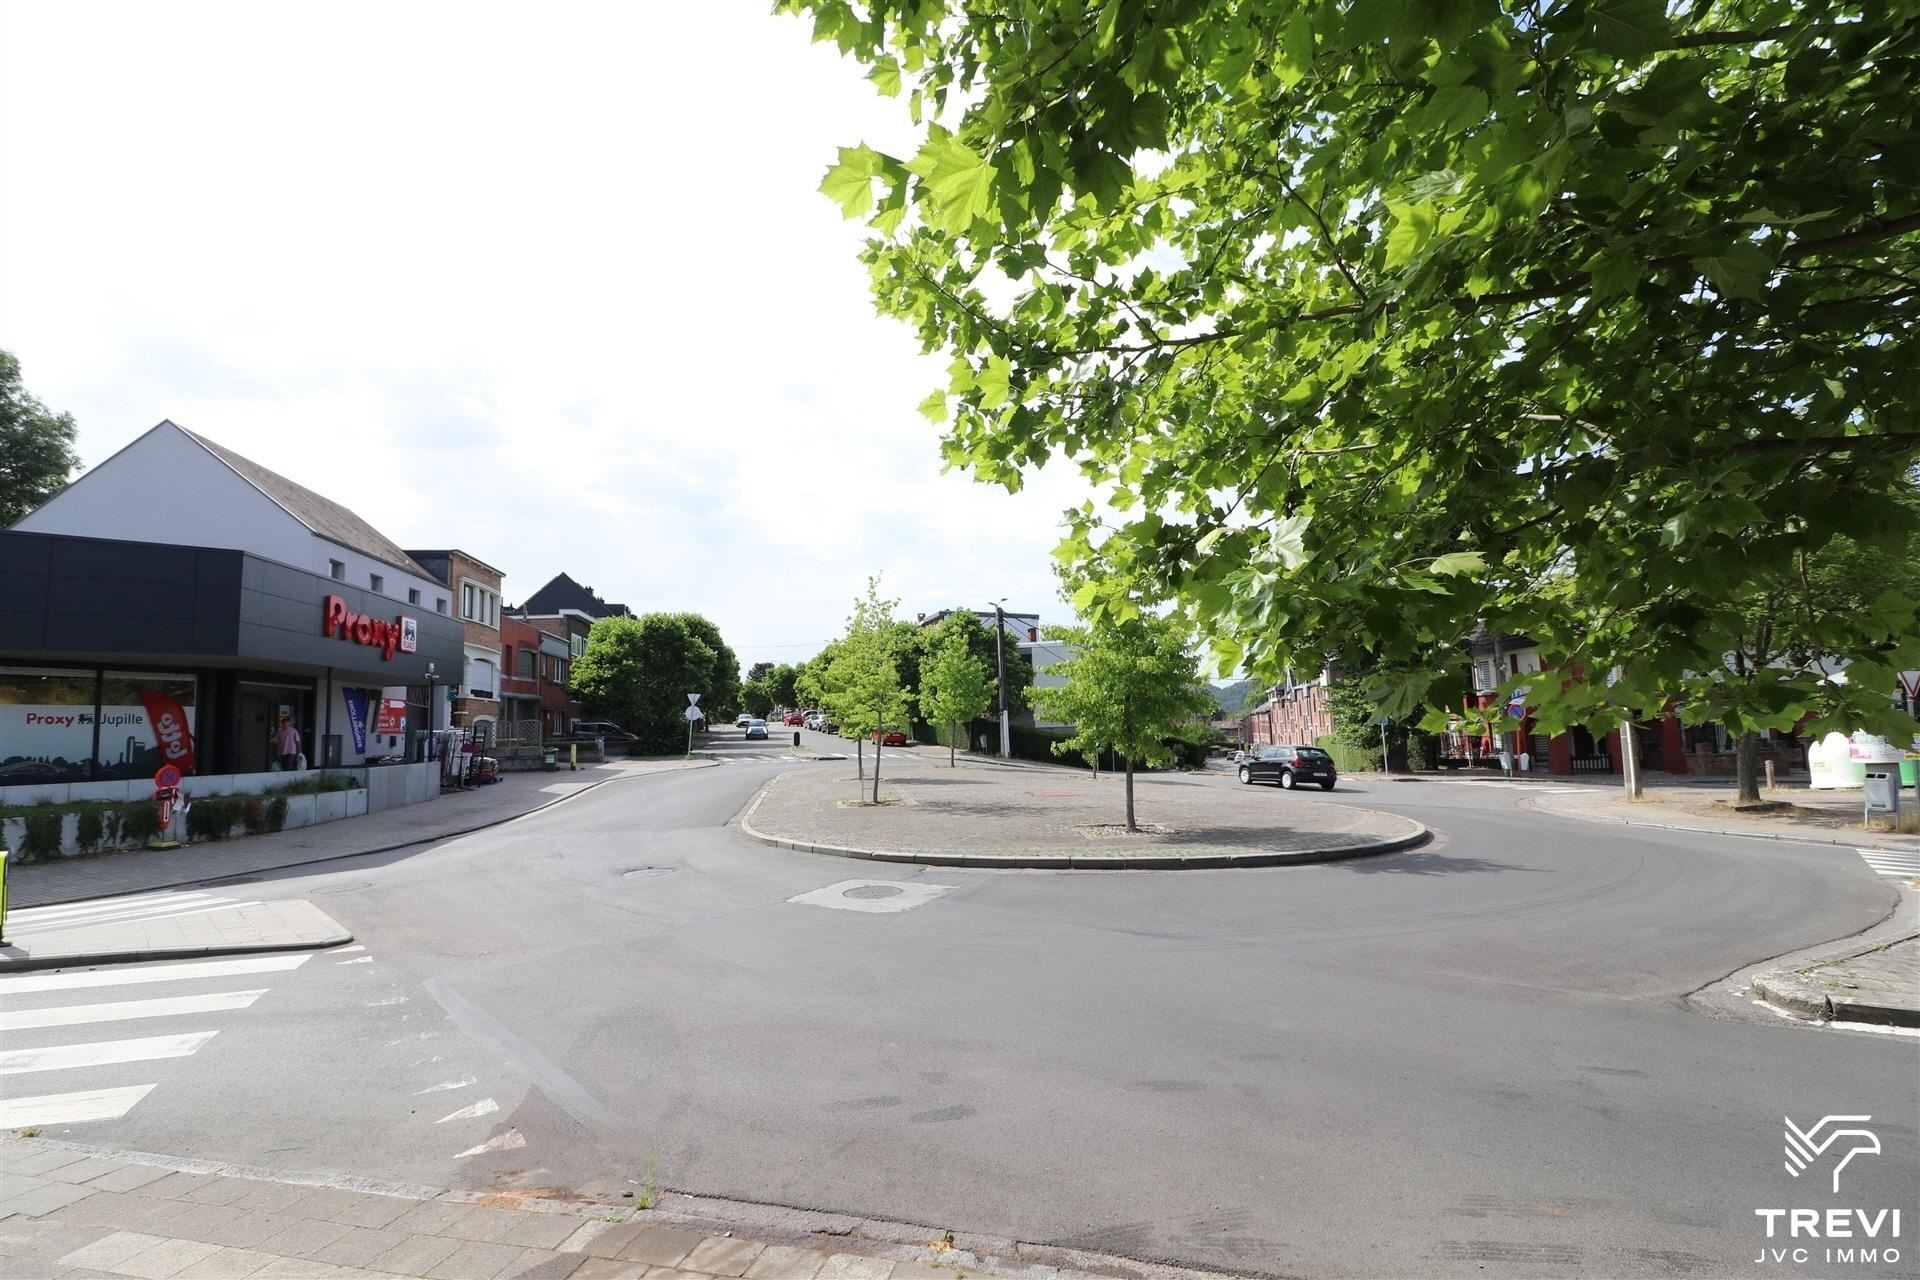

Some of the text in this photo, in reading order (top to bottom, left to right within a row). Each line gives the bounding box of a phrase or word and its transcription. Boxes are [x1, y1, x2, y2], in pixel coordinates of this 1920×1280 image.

[324, 594, 399, 662] Proxy
[26, 713, 143, 727] Proxy Jupille
